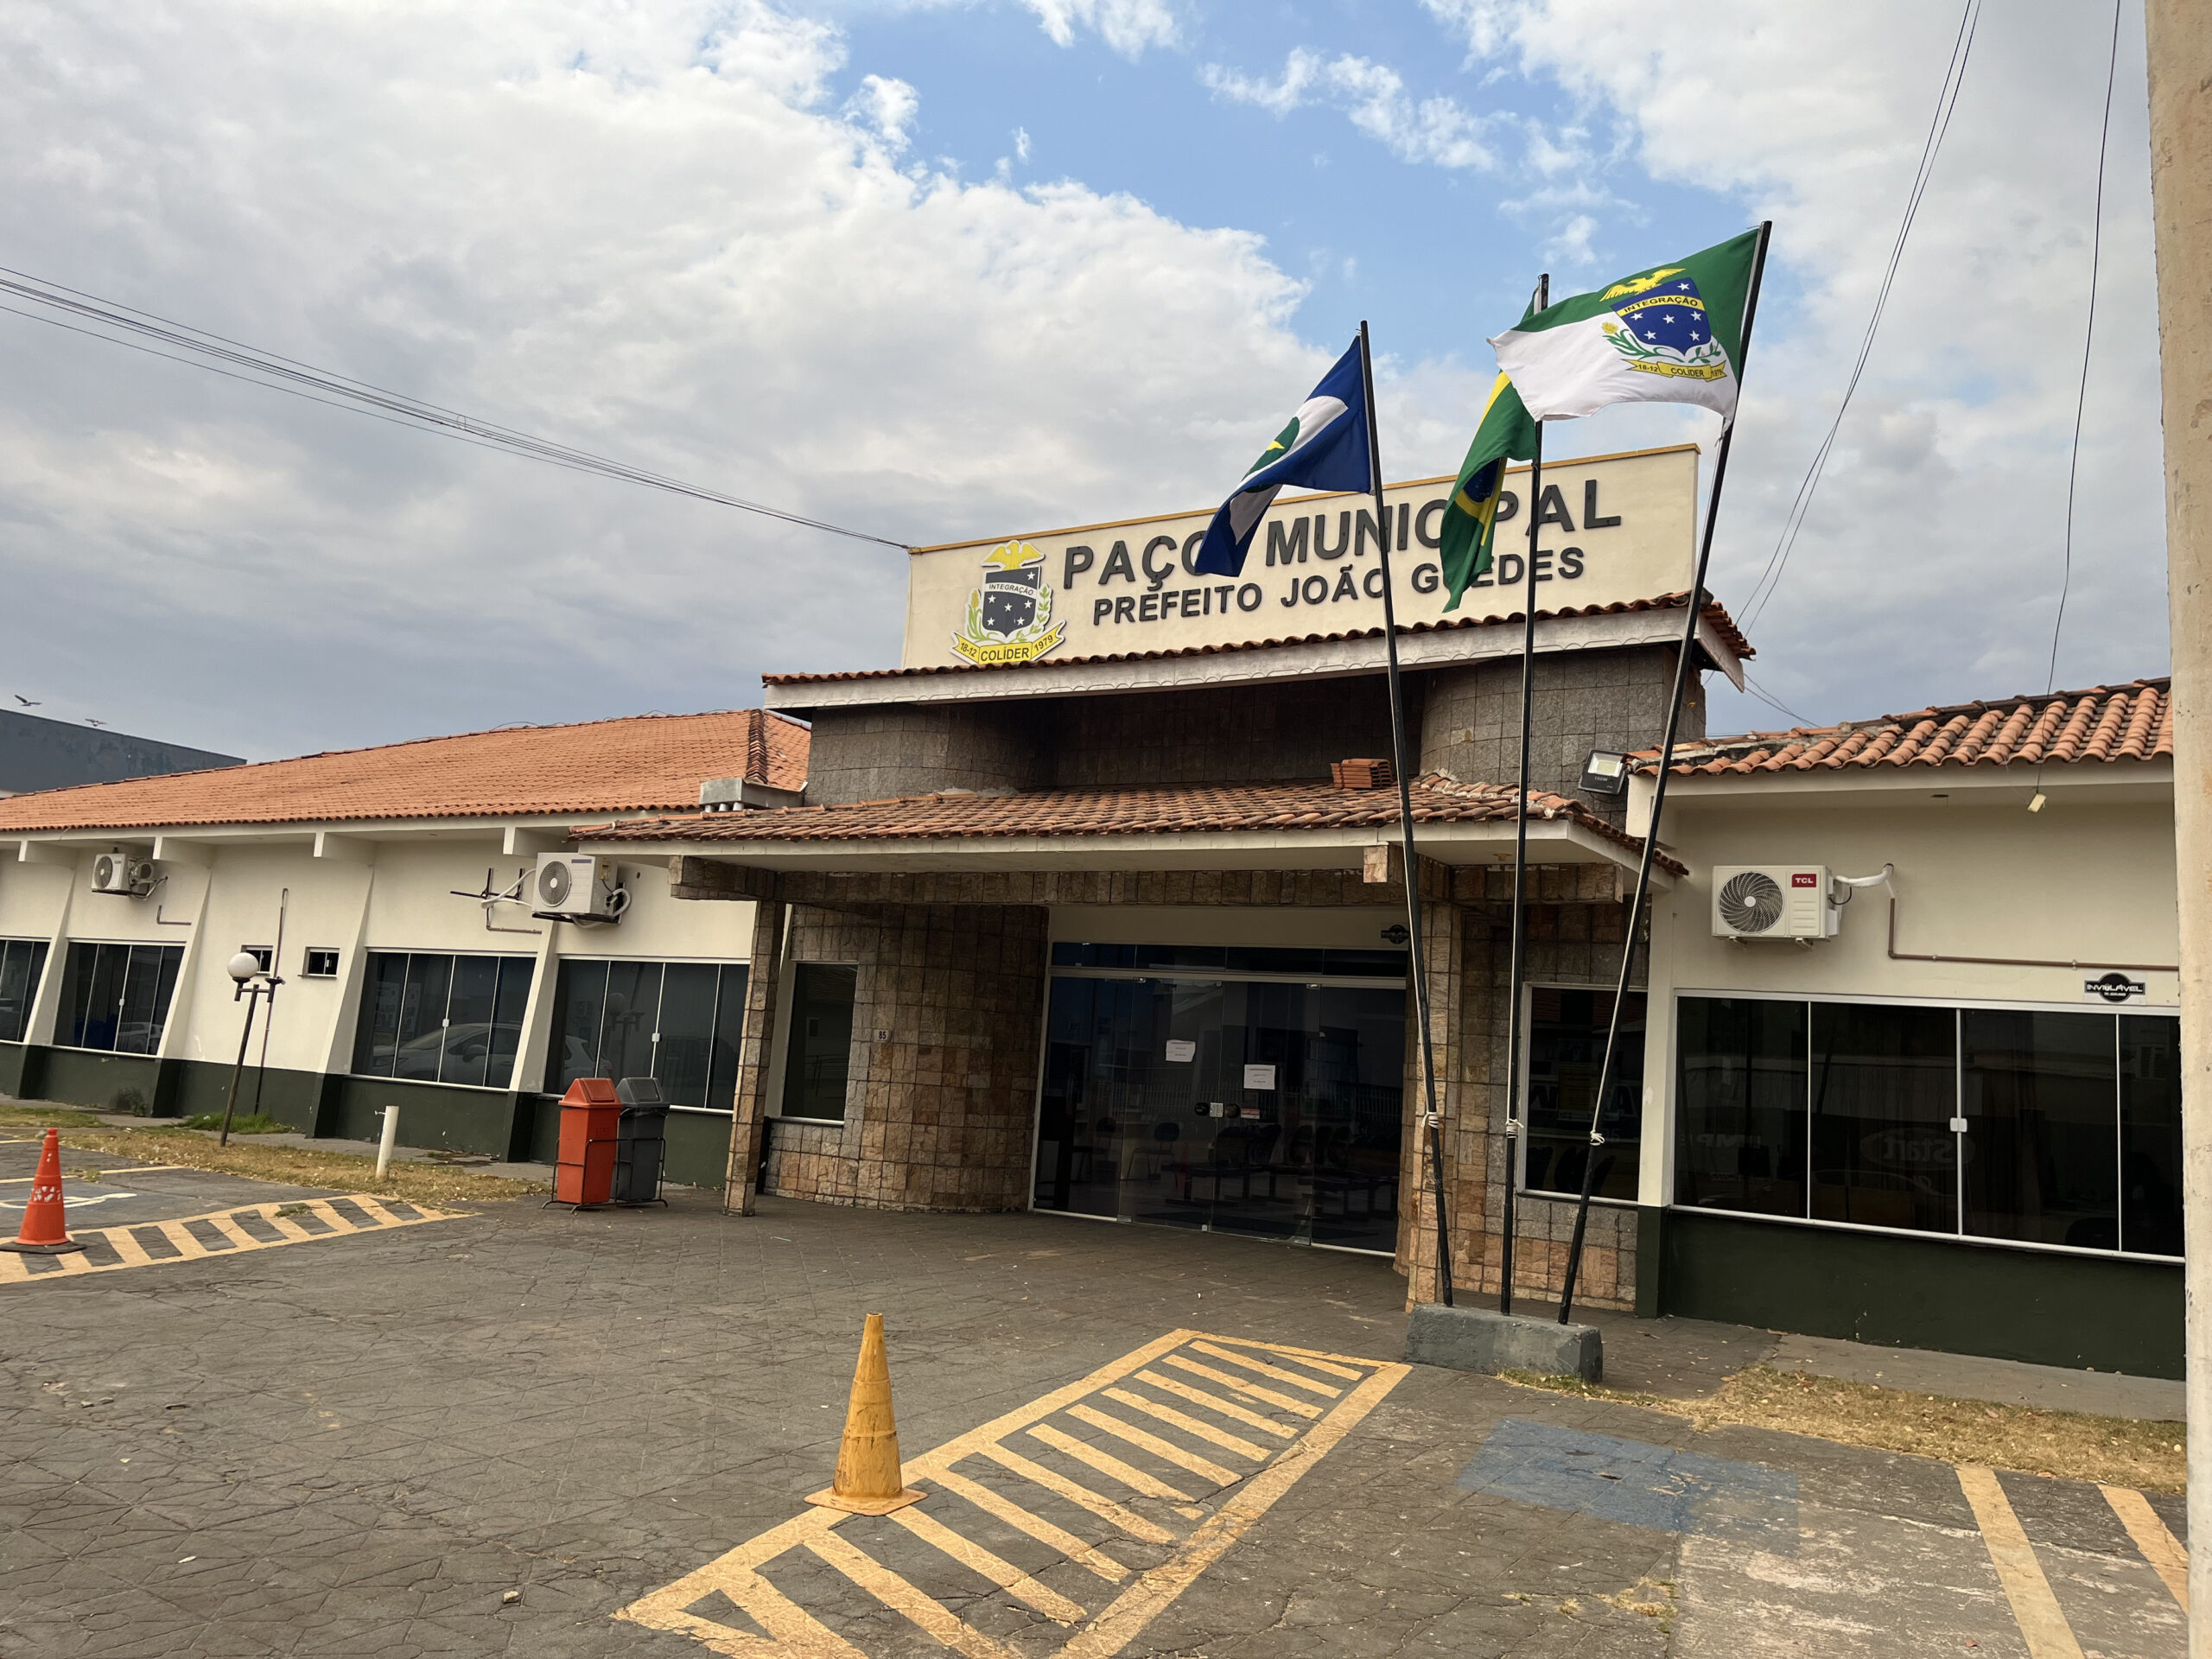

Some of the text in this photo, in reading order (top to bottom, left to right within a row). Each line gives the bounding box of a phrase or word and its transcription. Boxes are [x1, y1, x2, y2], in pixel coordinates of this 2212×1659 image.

[1624, 296, 1698, 313] INTEGRAÇÃO
[1638, 364, 1658, 372] 18-12
[1265, 479, 1622, 567] MUNICAL
[988, 583, 1034, 596] INTEGRAÇÃO
[1093, 546, 1584, 626] PREFEITO JOÃO GDES
[960, 634, 1053, 662] 18-12 COLÍDER 1979
[2087, 982, 2143, 993] INVIOLÁVEL
[879, 1030, 887, 1039] 85
